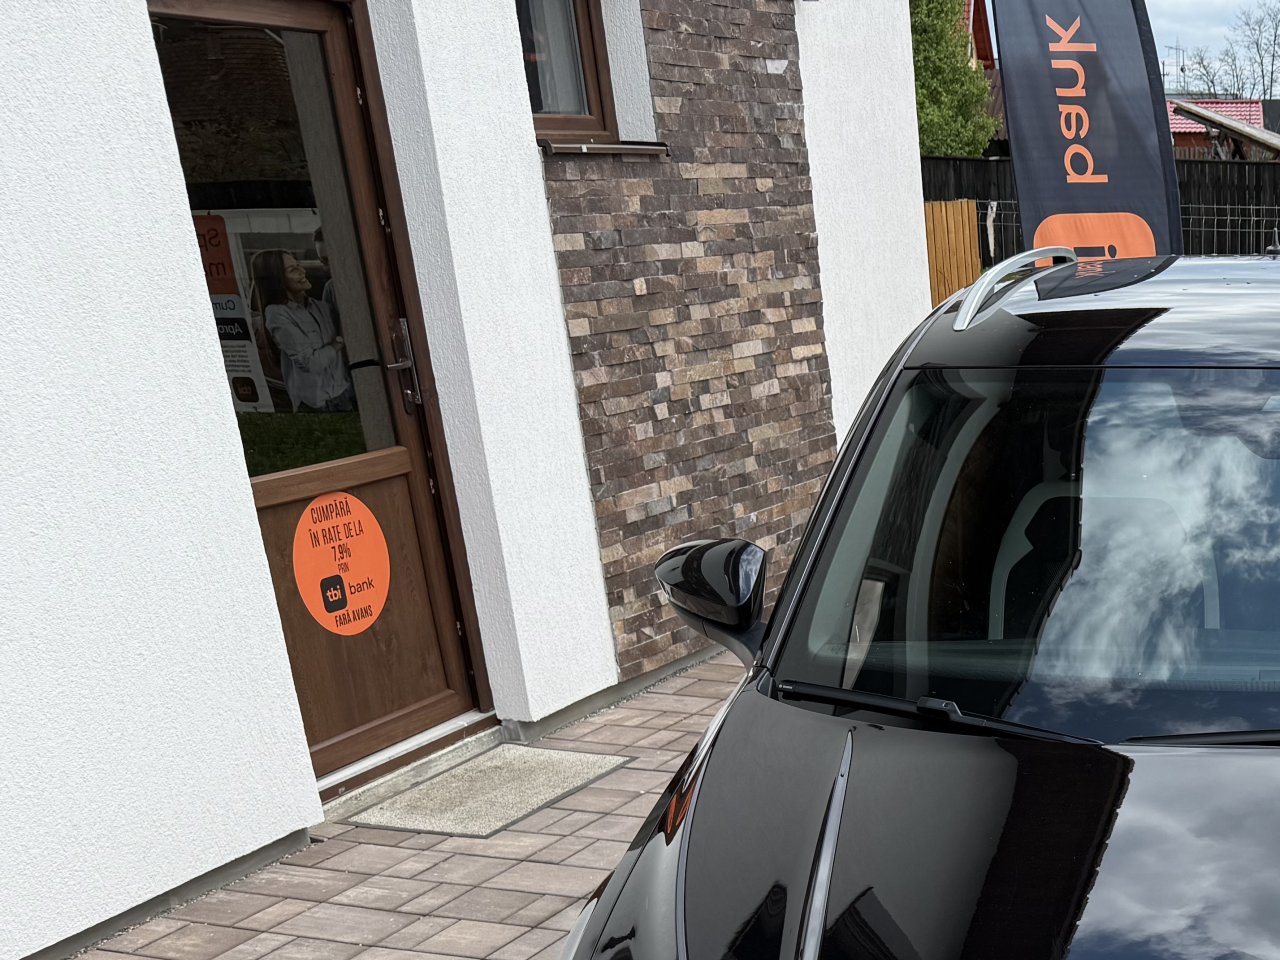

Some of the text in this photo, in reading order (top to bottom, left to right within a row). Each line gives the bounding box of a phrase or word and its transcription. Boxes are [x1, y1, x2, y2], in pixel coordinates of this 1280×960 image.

[311, 497, 352, 525] CUMPĂRĂ
[308, 519, 364, 548] ÎN RATE DE LA
[331, 544, 352, 562] 7,9%
[326, 577, 375, 602] tbi bank
[352, 604, 374, 622] AVANS
